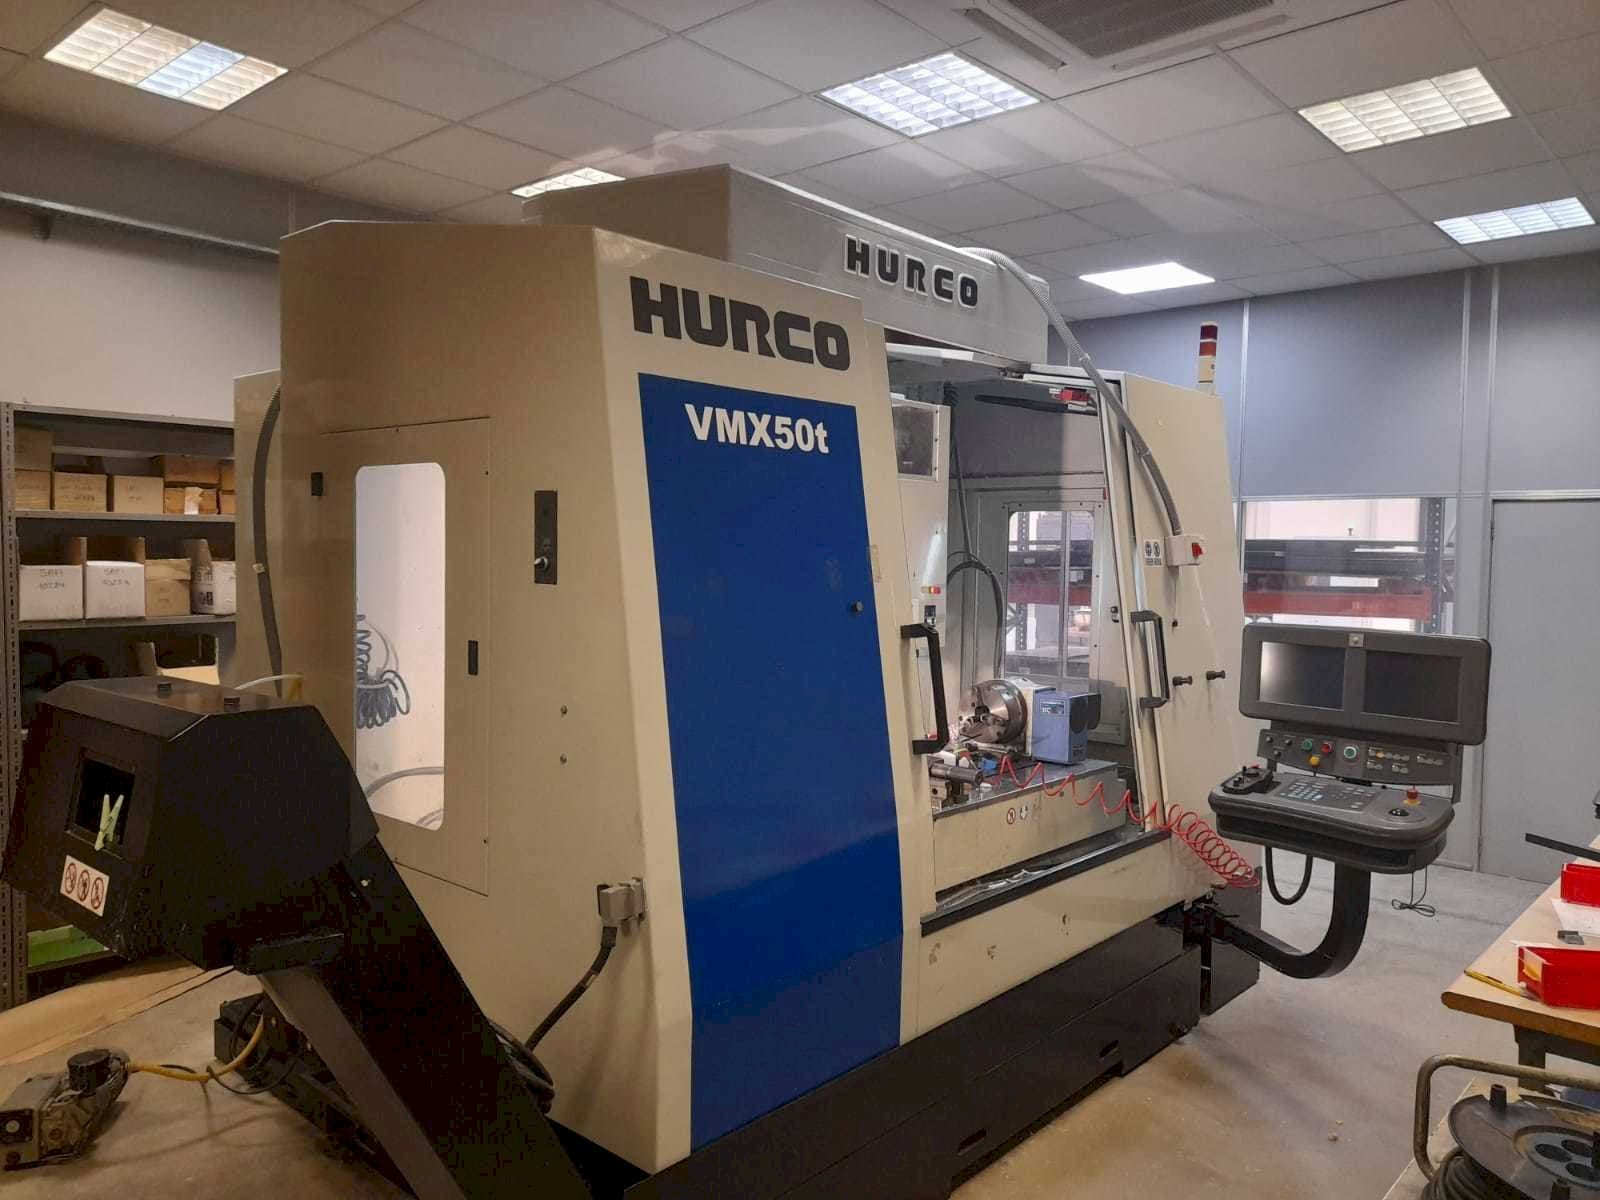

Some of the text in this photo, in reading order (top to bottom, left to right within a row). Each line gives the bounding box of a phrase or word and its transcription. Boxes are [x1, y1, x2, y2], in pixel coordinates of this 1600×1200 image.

[846, 236, 979, 308] HURCO
[630, 275, 851, 372] HURCO
[685, 403, 830, 454] VMX50t
